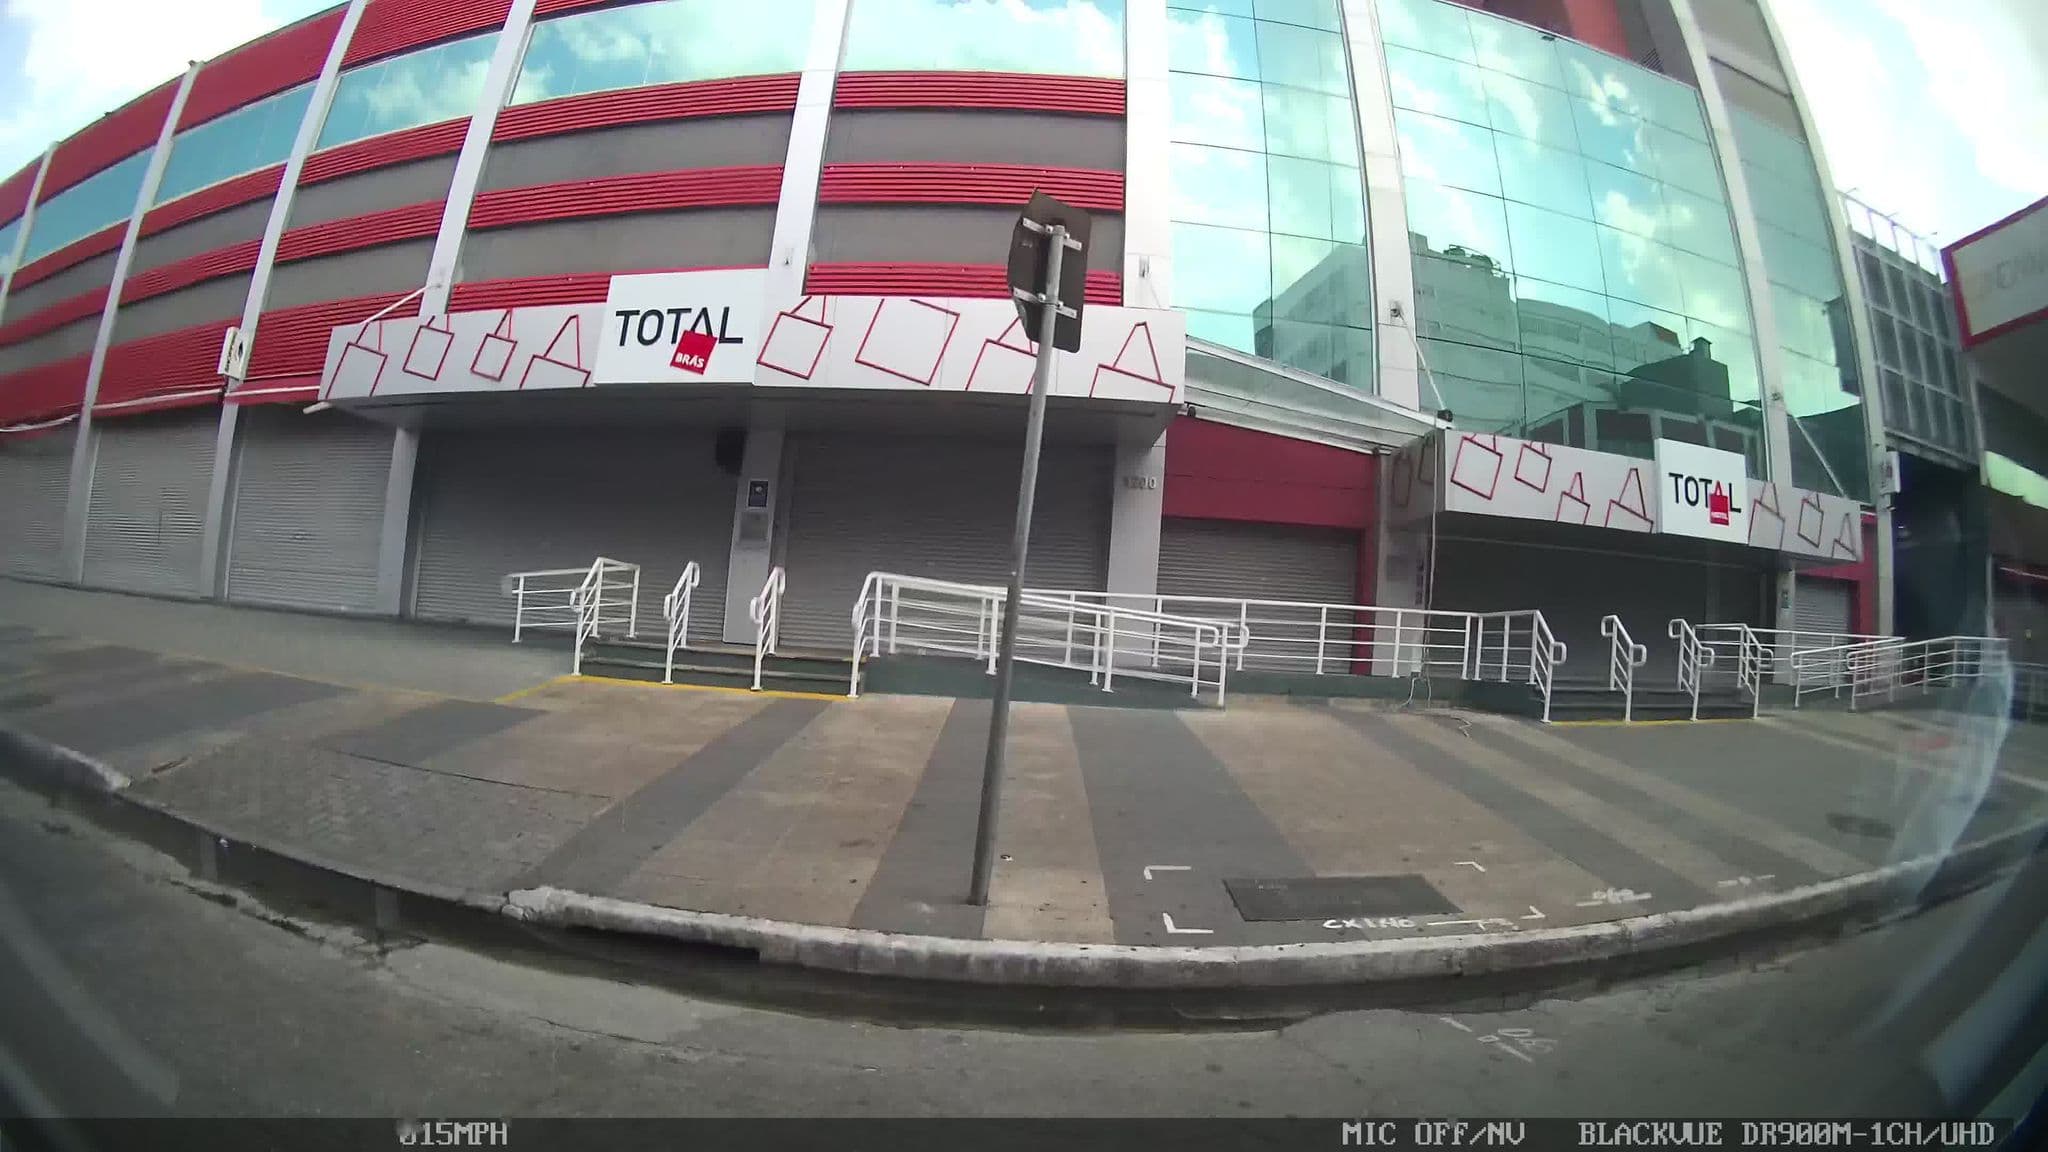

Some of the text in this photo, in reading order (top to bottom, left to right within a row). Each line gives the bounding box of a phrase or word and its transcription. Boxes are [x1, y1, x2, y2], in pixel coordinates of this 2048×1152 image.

[615, 306, 744, 346] TOTAL
[674, 352, 705, 368] BRÁS
[1668, 472, 1742, 513] TOTAL
